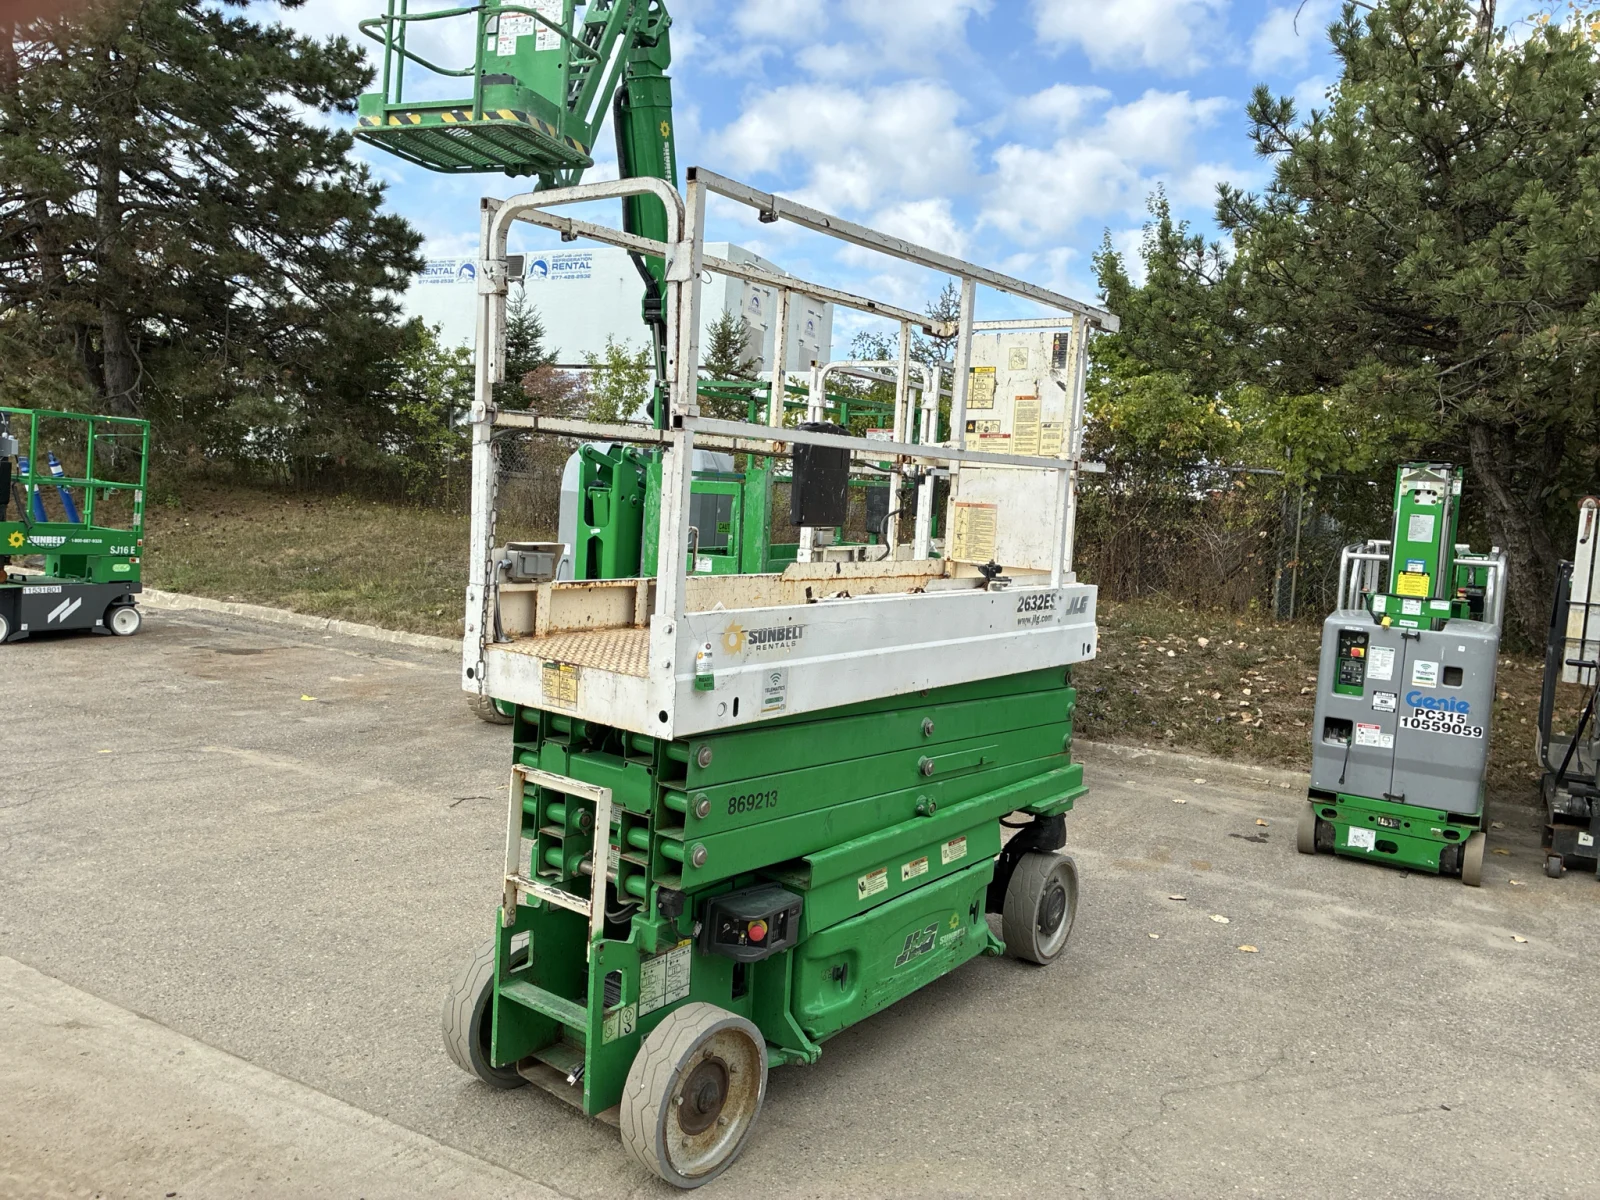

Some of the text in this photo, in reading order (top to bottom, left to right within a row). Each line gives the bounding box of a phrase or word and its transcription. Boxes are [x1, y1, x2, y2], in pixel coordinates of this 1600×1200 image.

[552, 262, 592, 270] RENTAL
[110, 546, 136, 554] SJ16 E
[1066, 596, 1089, 615] JLG
[1018, 614, 1053, 626] www.jlg.com
[748, 625, 804, 645] SUNBELT
[756, 641, 796, 651] RENTALS
[1406, 690, 1470, 714] Genie
[1415, 708, 1466, 724] PC315
[1402, 717, 1483, 737] 10559059
[728, 790, 778, 815] 869213
